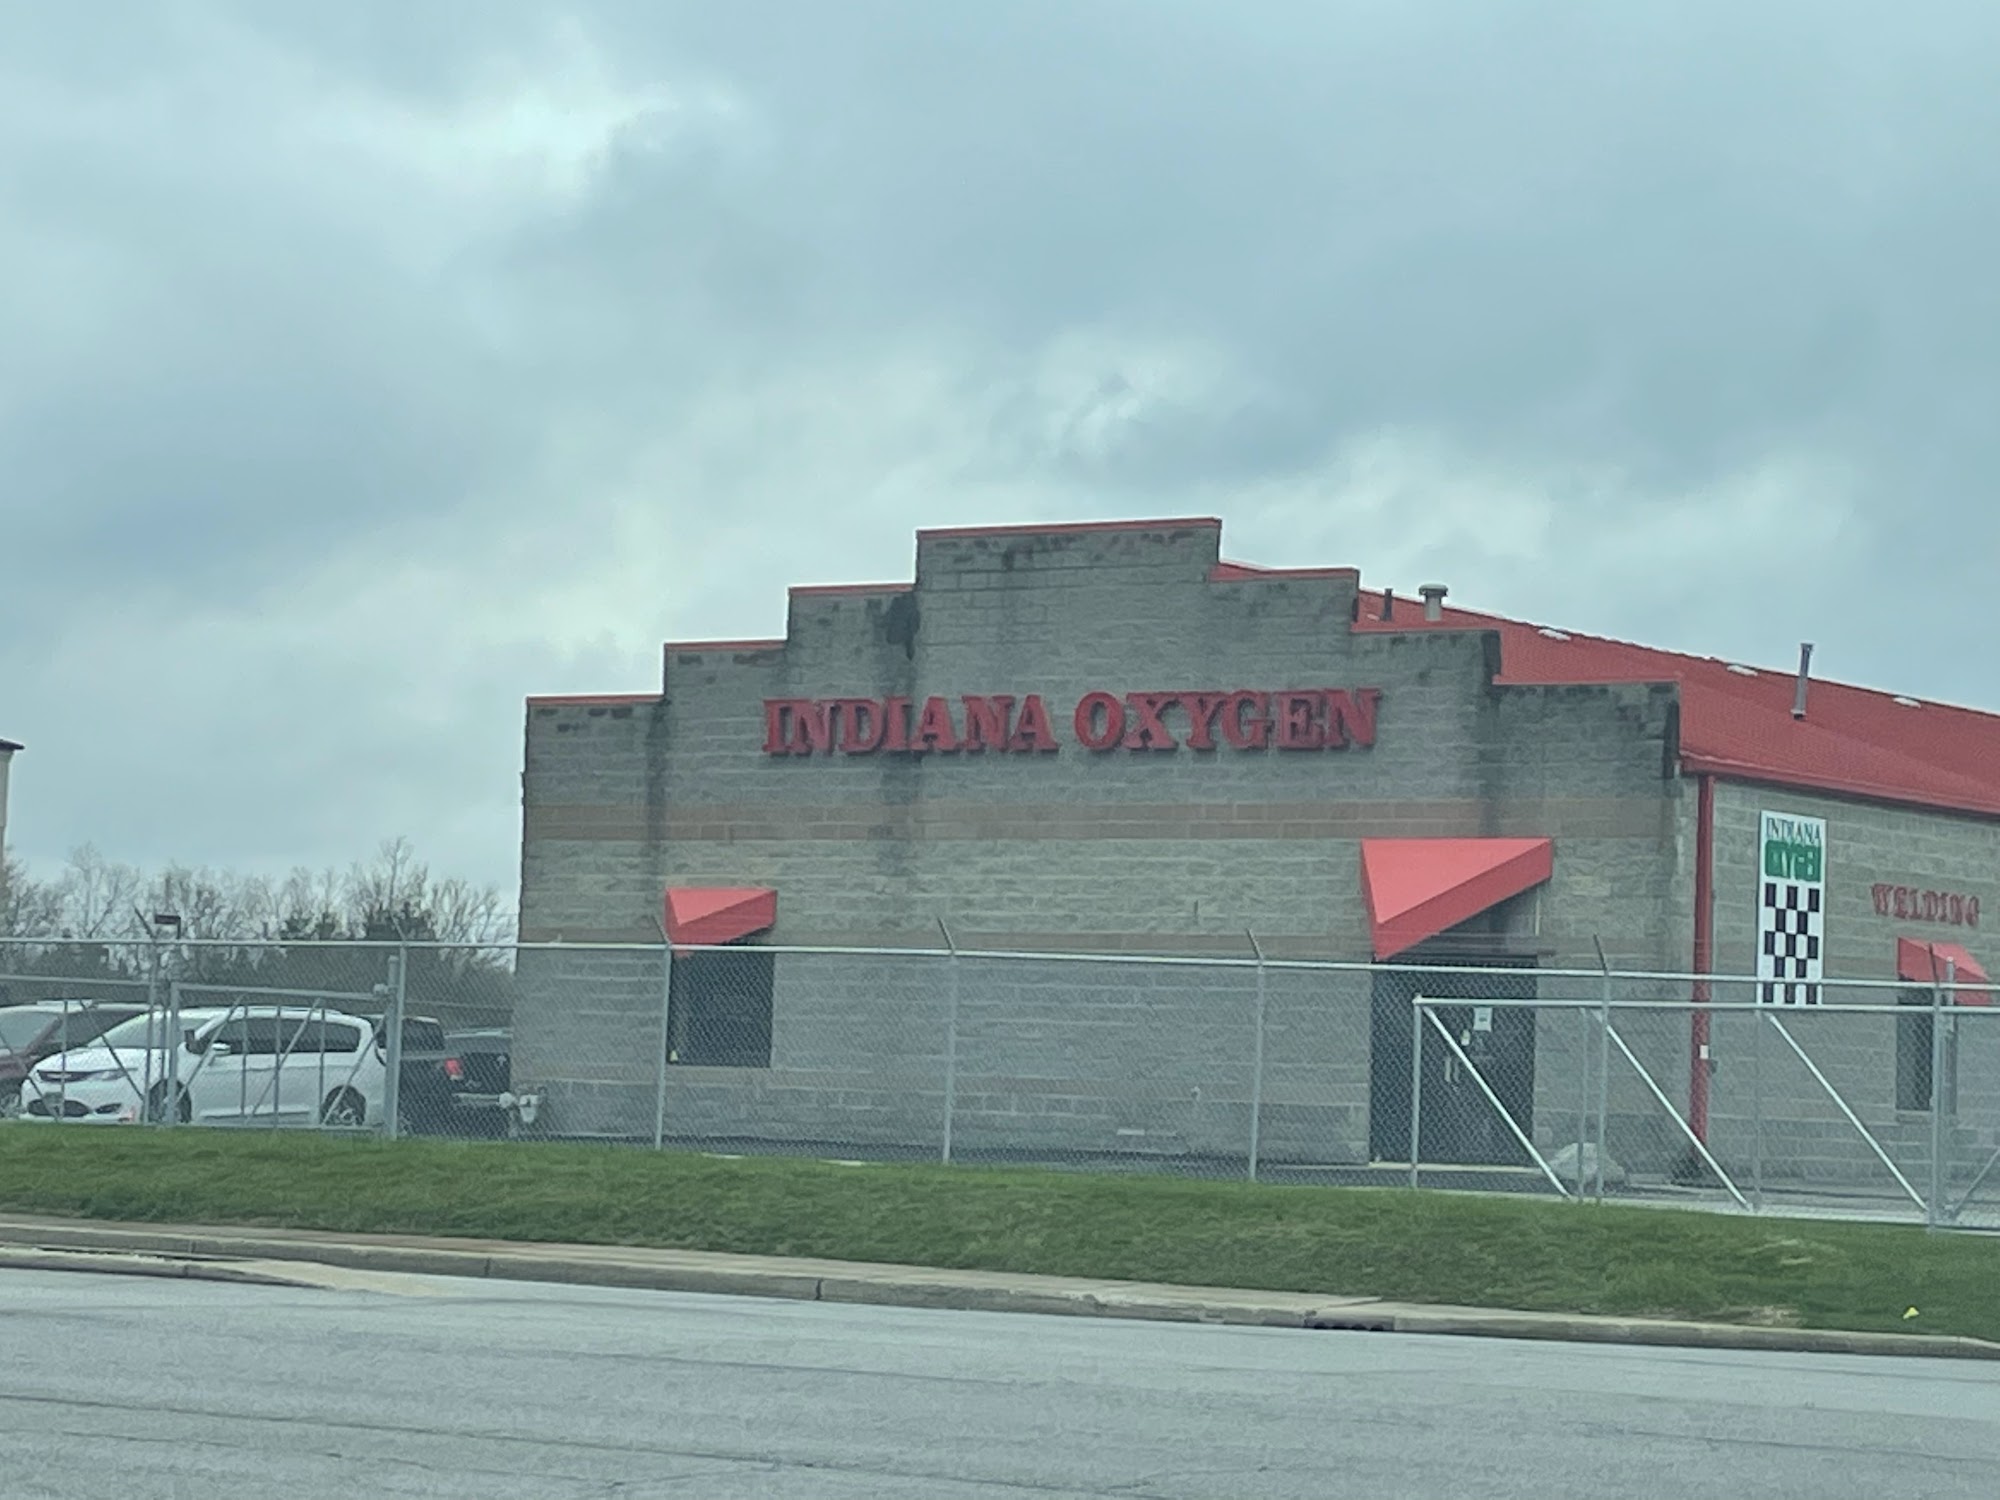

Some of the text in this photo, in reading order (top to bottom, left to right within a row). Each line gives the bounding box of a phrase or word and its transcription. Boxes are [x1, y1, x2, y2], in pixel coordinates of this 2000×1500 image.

[762, 688, 1381, 757] INDIANA OXYGEN
[1871, 883, 1980, 927] WELDING
